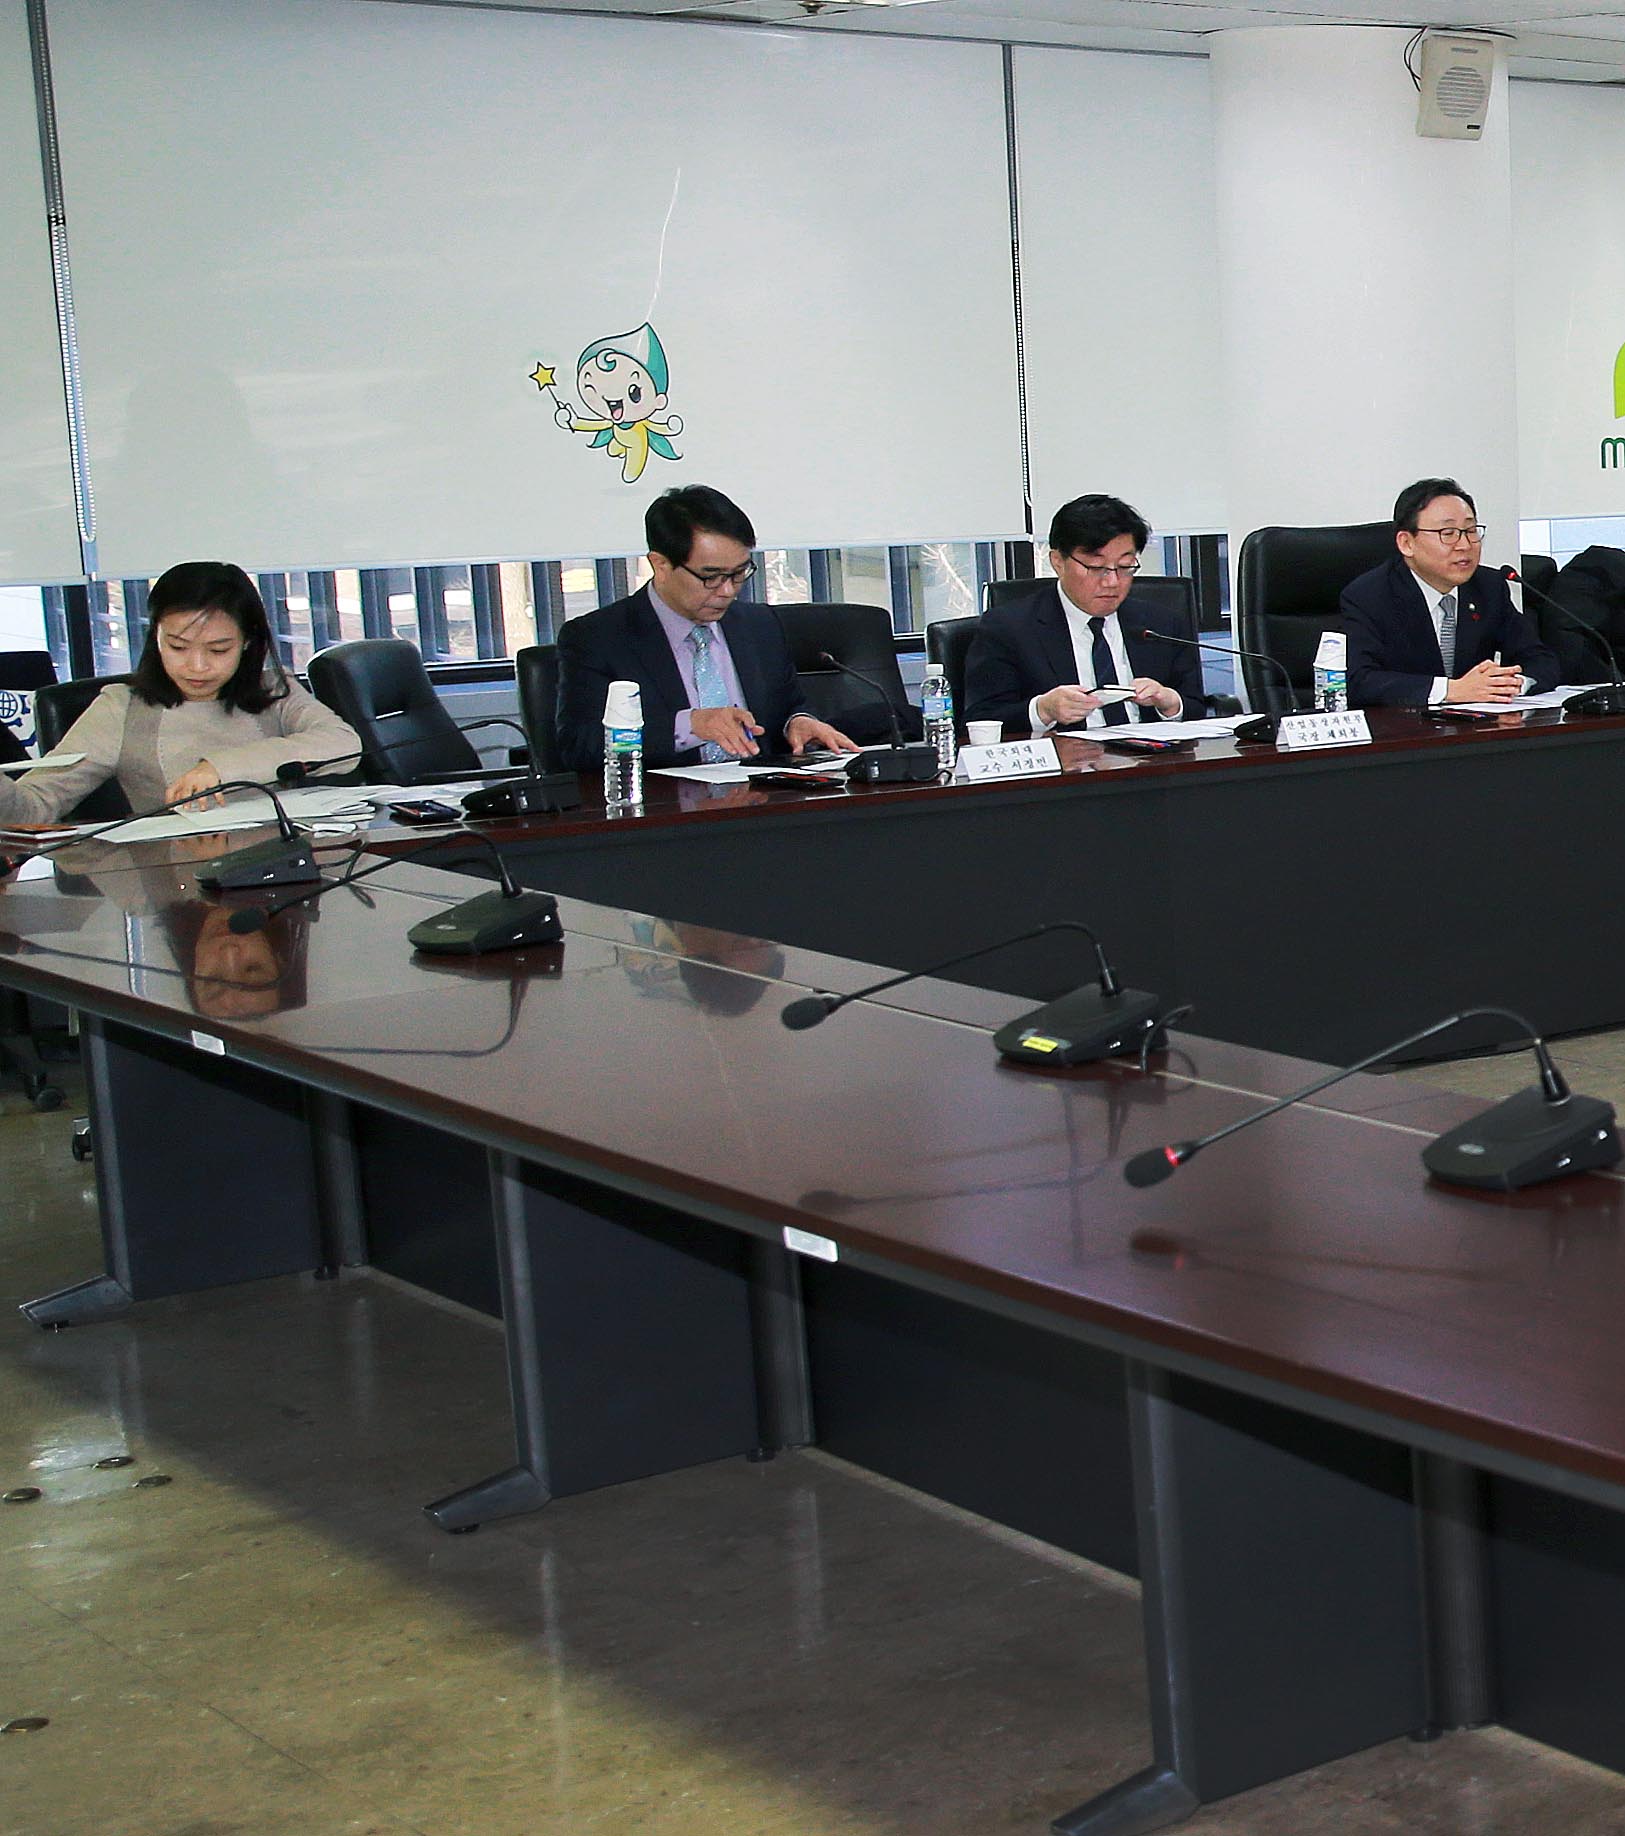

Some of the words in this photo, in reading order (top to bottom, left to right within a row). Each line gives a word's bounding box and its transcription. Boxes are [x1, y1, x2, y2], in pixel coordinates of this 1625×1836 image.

[1286, 714, 1362, 730] 산업통상자원부
[1298, 731, 1320, 742] 국장
[986, 745, 1033, 758] 한국외대
[980, 761, 1002, 773] 교수
